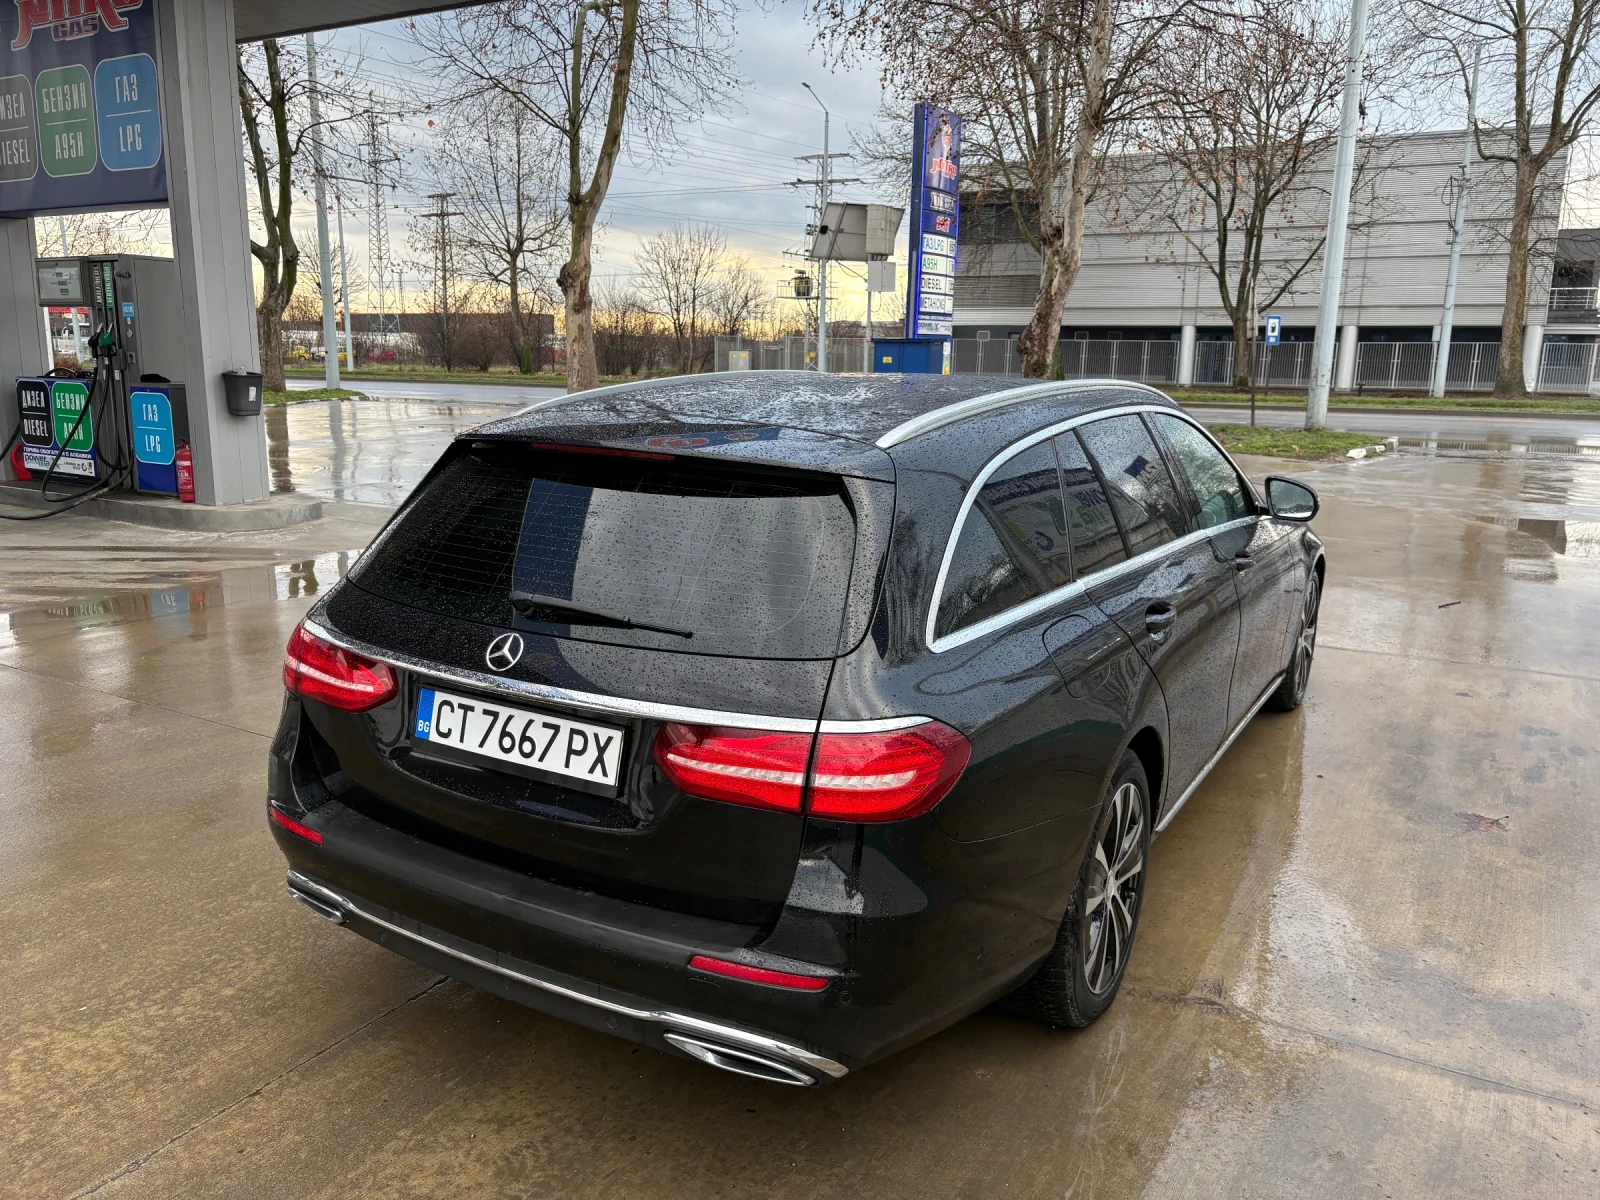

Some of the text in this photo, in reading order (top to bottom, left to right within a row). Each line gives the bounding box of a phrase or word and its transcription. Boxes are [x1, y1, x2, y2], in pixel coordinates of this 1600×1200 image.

[52, 14, 100, 41] GAS
[115, 73, 139, 103] ГАЗ
[42, 82, 87, 114] БЕНЗИН
[119, 123, 142, 152] LPG
[921, 277, 942, 291] DIESEL
[22, 390, 46, 409] ДИЗЕЛ
[142, 403, 158, 422] ГАЗ
[23, 419, 49, 437] DIESEL
[145, 434, 161, 453] LPG
[417, 719, 430, 732] BG
